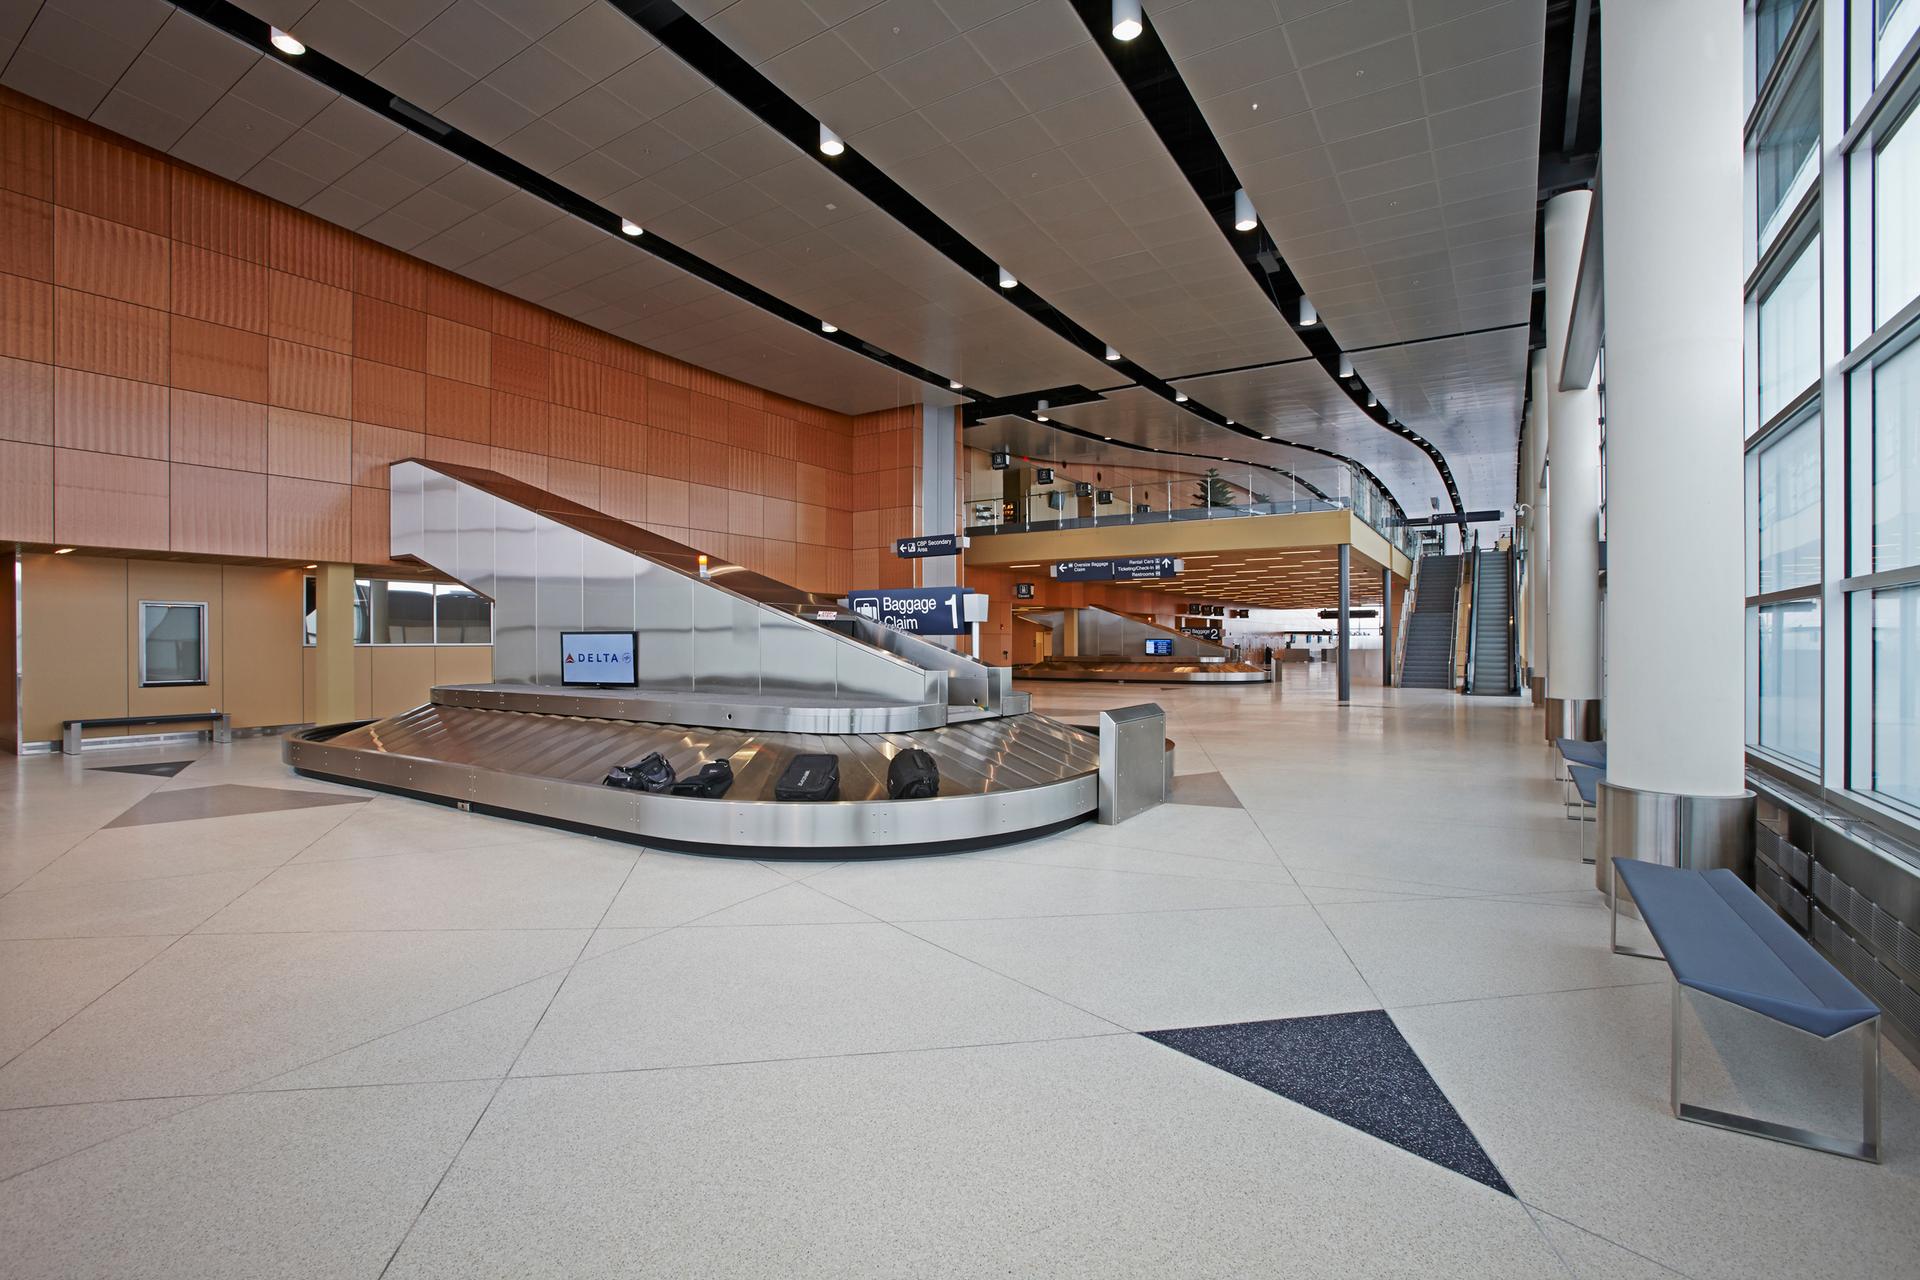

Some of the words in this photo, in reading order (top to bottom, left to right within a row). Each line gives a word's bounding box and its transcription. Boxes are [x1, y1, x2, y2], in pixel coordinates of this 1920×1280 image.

[883, 596, 937, 614] Baggage
[944, 594, 959, 629] 1
[884, 615, 919, 630] Claim
[1210, 628, 1219, 639] 2
[578, 653, 619, 663] DELTA
